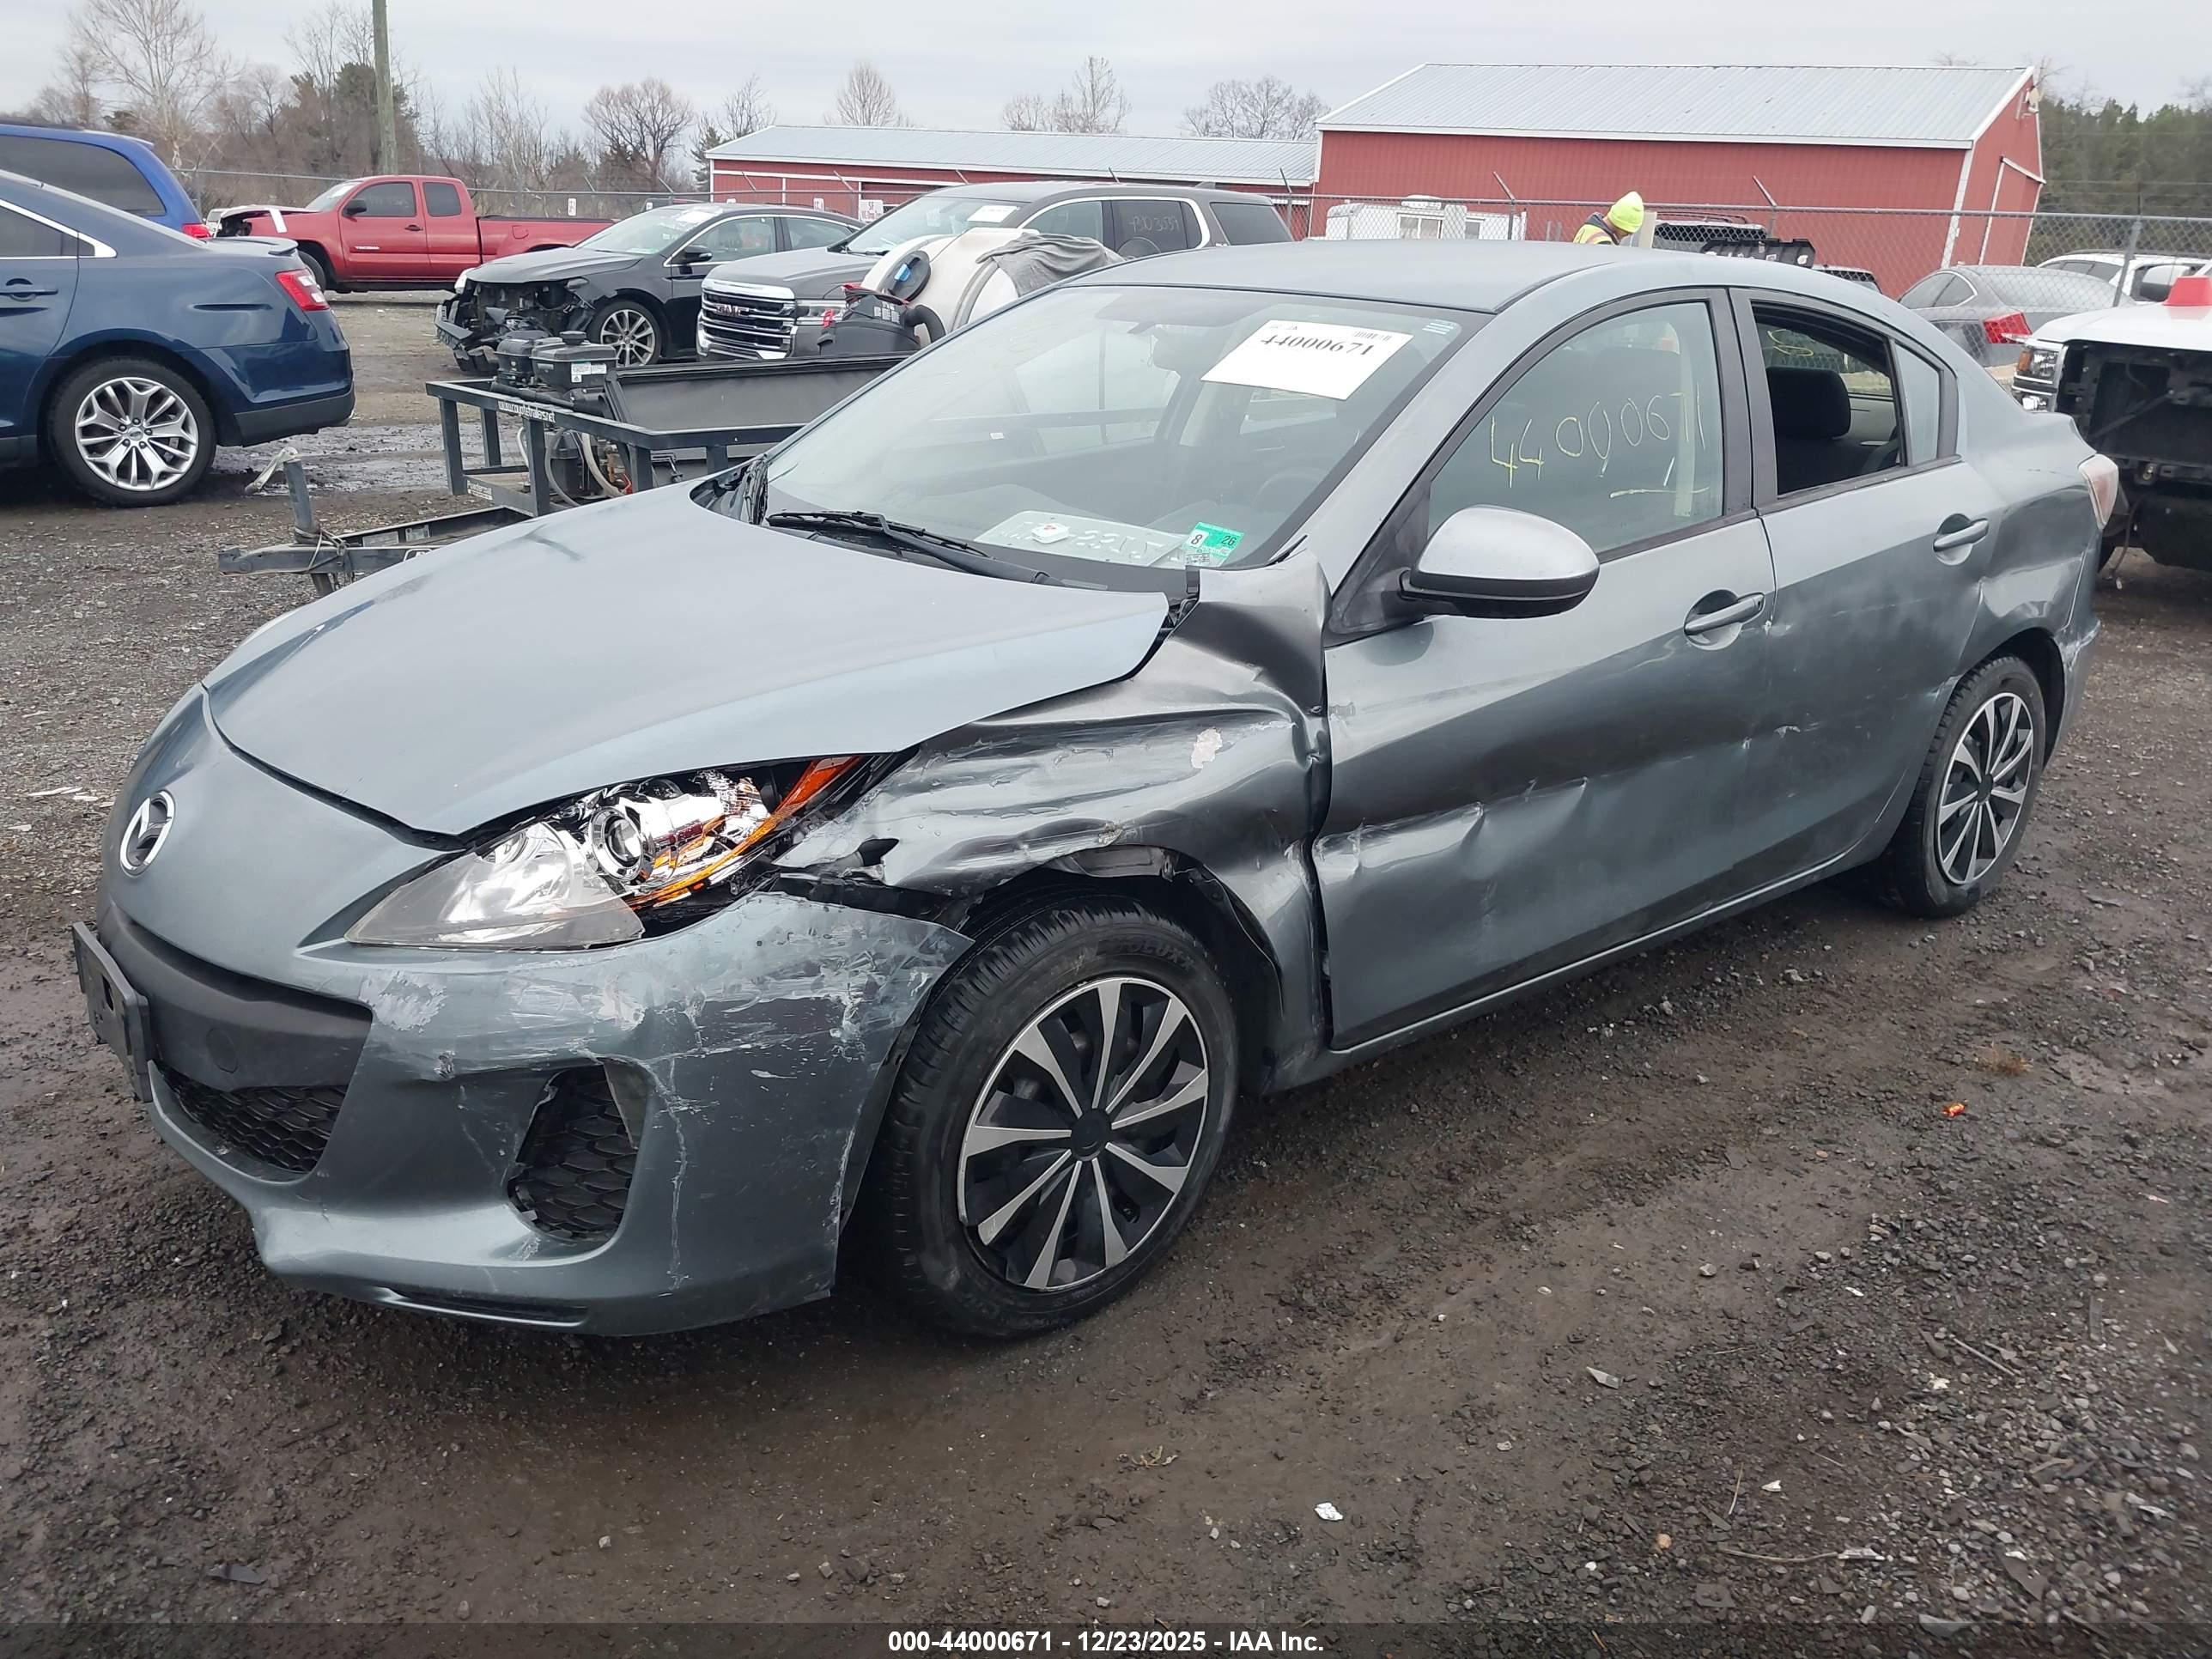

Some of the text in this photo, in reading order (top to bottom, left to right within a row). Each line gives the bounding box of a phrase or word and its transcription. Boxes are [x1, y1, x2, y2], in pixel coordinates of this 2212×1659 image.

[715, 304, 750, 319] GMC
[1261, 334, 1375, 356] 44000671
[1490, 384, 1705, 488] 44000671
[1191, 534, 1237, 546] 8 26
